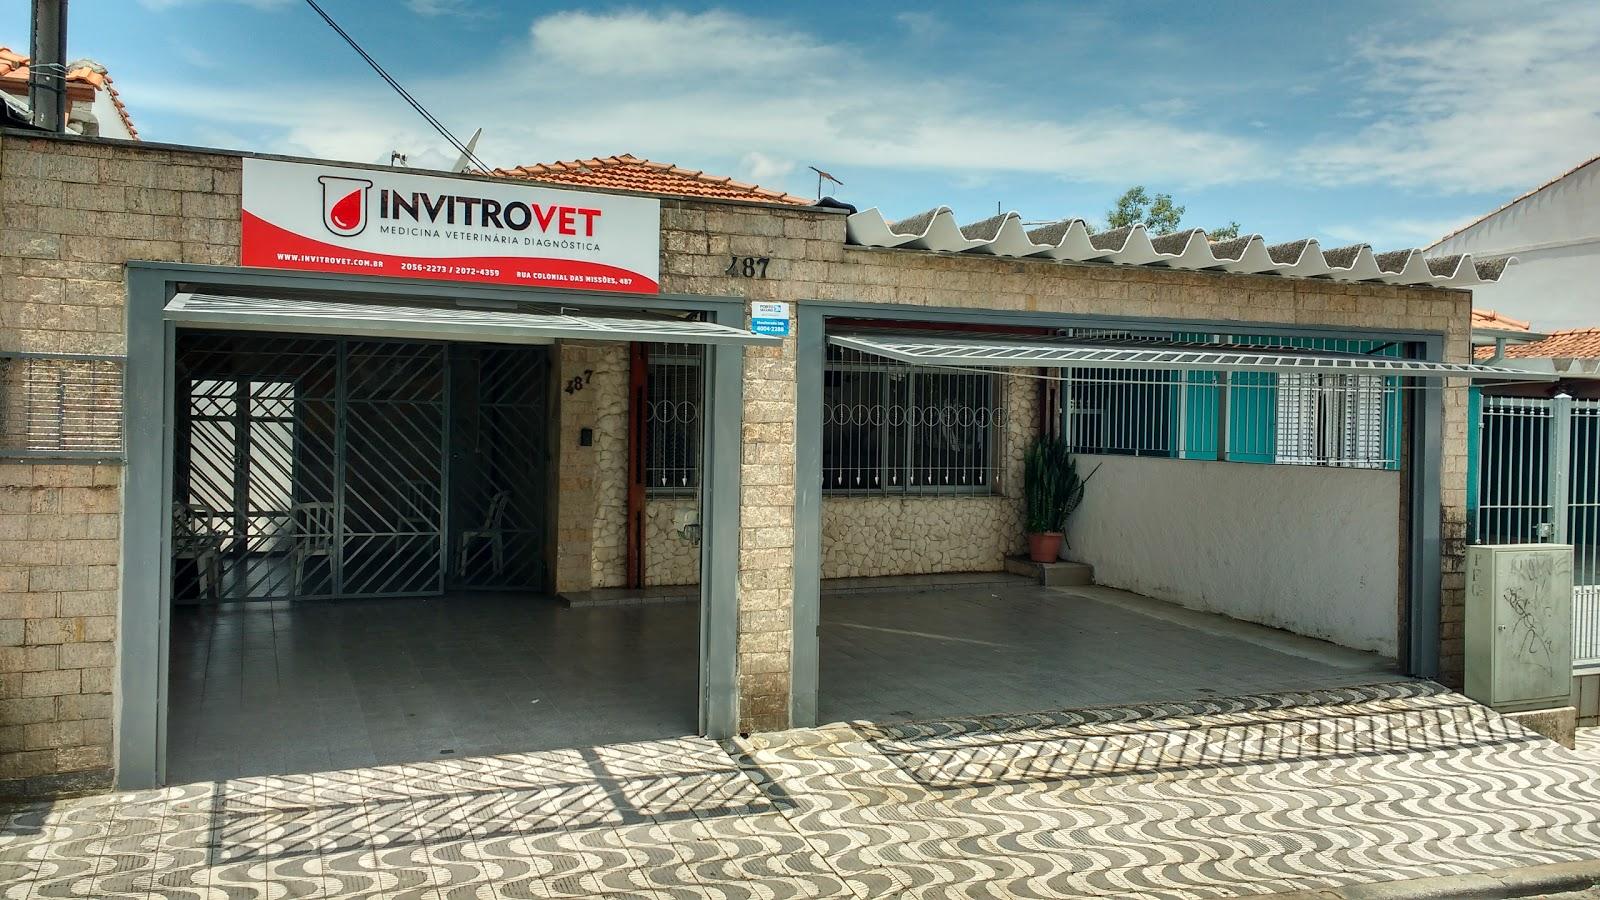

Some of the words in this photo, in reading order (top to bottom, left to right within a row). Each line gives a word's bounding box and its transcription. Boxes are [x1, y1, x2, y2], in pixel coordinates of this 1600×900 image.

[380, 188, 602, 237] INVITROVET
[380, 225, 440, 238] MEDICINA
[445, 230, 519, 245] VETERINÁRIA
[524, 237, 601, 251] DIAGNÓSTICA
[276, 252, 384, 268] WWW.INVITROVET.COM.BR
[401, 262, 447, 273] 2056-2273
[455, 266, 500, 277] 2072-4359
[725, 256, 770, 278] 487
[516, 271, 531, 279] RUA
[533, 272, 568, 281] COLONIAL
[585, 275, 618, 285] MISSÕES,
[565, 369, 593, 395] 487
